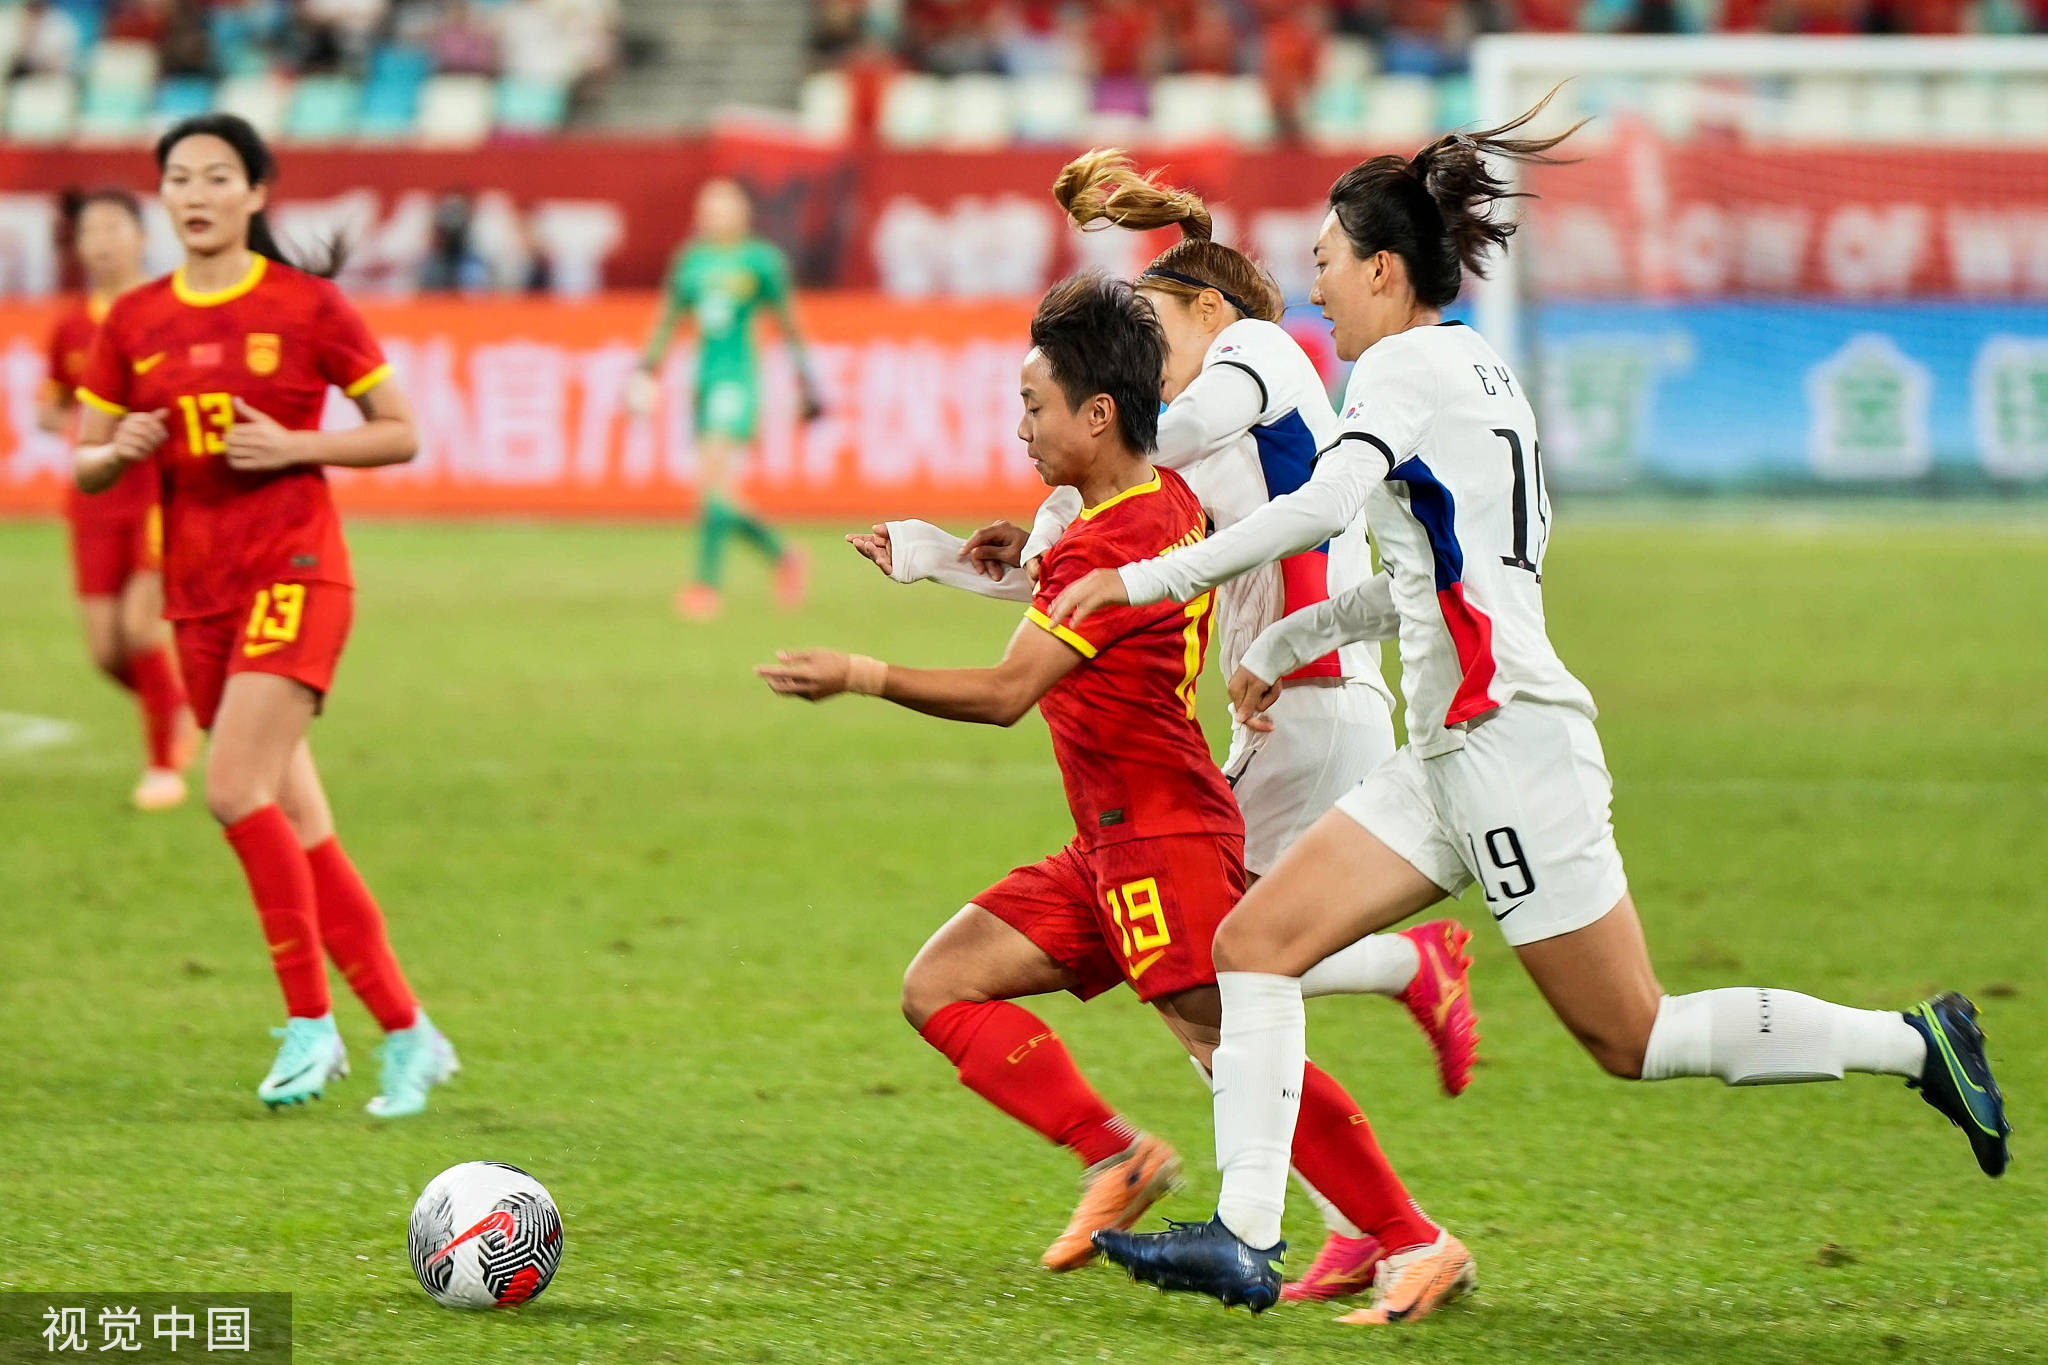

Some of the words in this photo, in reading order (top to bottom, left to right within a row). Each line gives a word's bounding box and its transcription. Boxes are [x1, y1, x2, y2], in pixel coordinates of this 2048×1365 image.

[177, 391, 235, 457] 13
[246, 582, 306, 643] 13
[1466, 826, 1536, 903] 19
[1106, 876, 1172, 958] 19
